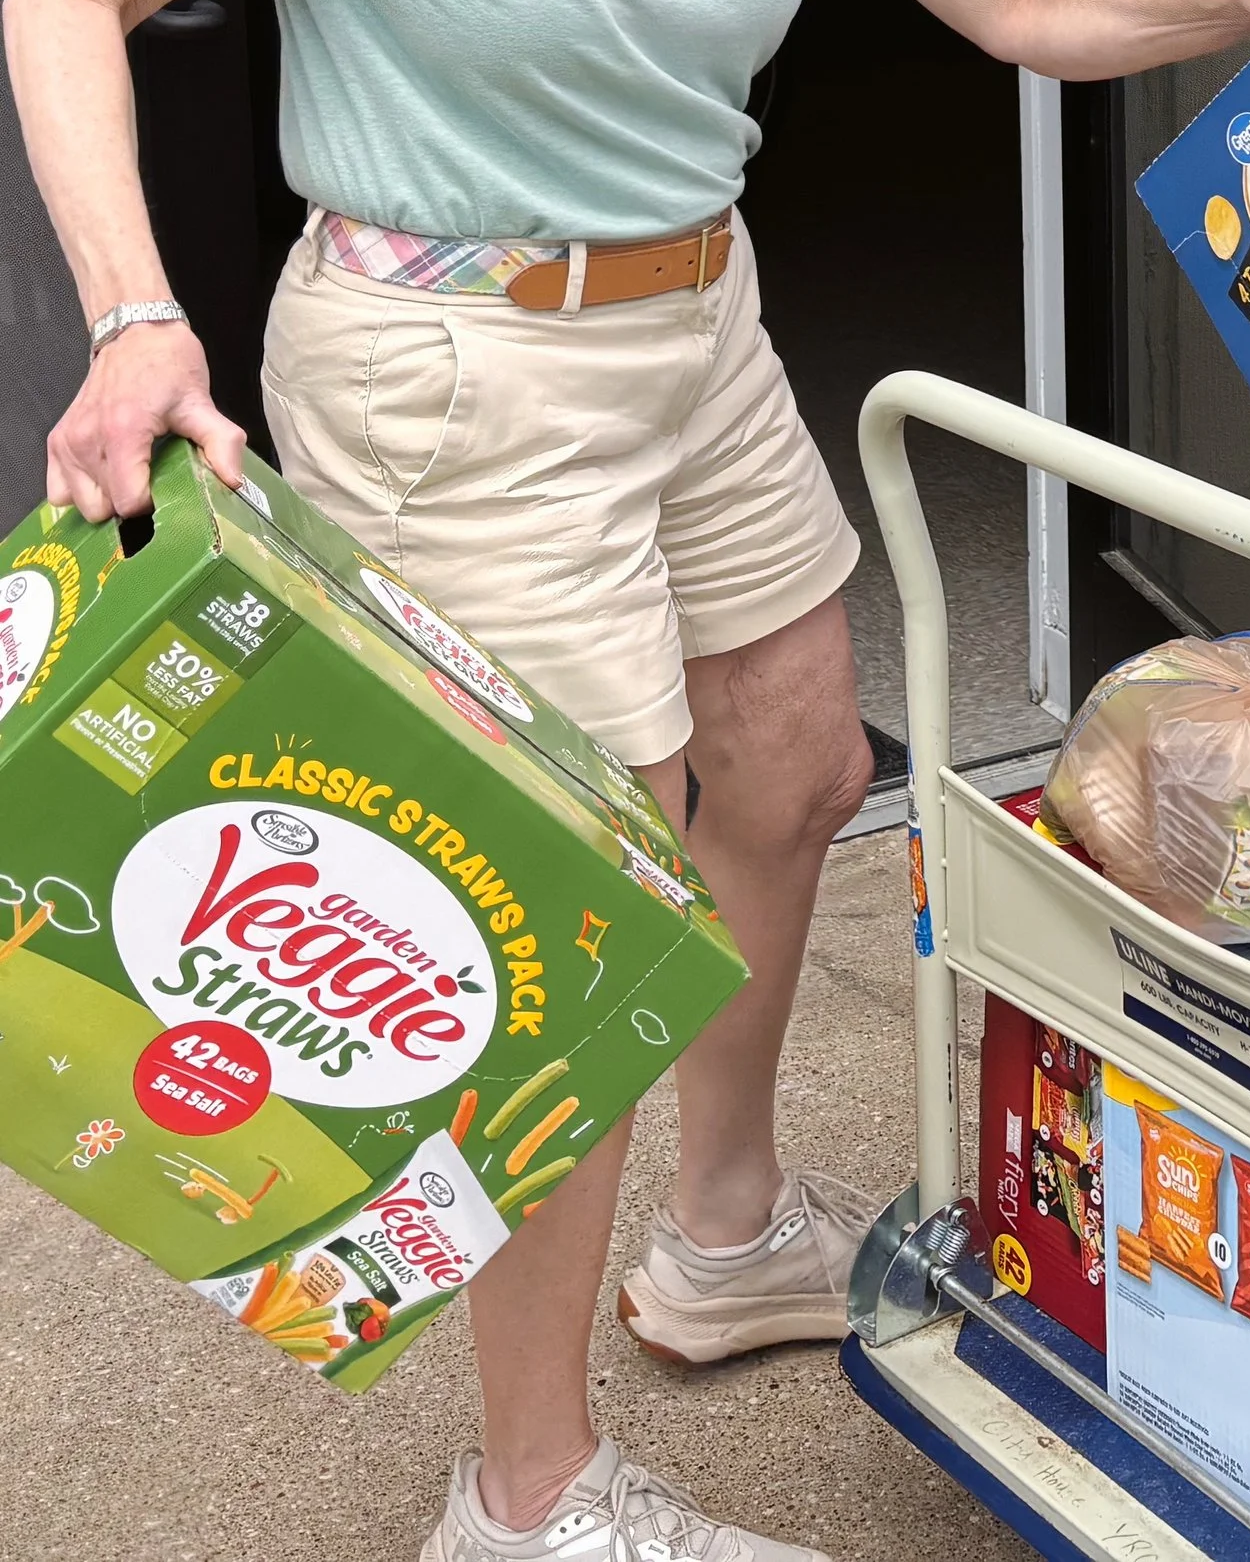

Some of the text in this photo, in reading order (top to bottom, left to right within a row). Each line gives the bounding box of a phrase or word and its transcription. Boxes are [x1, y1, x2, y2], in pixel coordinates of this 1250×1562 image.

[1240, 282, 1250, 304] 4
[206, 601, 265, 649] STRAWS
[231, 591, 271, 628] 38
[146, 662, 178, 691] LESS
[159, 641, 216, 697] 30%
[79, 709, 154, 769] ARTIFICIAL
[112, 703, 156, 742] NO
[209, 754, 547, 1036] CLASSIC STRAWS PACK
[181, 824, 466, 1062] Veggie
[308, 893, 437, 972] garden
[1118, 937, 1172, 987] ULINE
[152, 945, 373, 1078] Straws
[1140, 980, 1157, 999] 600
[1176, 1003, 1221, 1037] CAPACITY
[170, 1034, 259, 1086] 42 BAGS
[150, 1074, 226, 1119] Sea Salt
[1000, 1157, 1024, 1232] fiery
[1157, 1153, 1199, 1193] Sun
[1171, 1180, 1200, 1204] CHIPS
[358, 1229, 421, 1286] Straws
[361, 1177, 465, 1290] Veggie
[998, 1240, 1007, 1270] BAGS
[1213, 1240, 1227, 1263] 10
[347, 1251, 388, 1293] Sea Salt
[1005, 1244, 1026, 1286] 42
